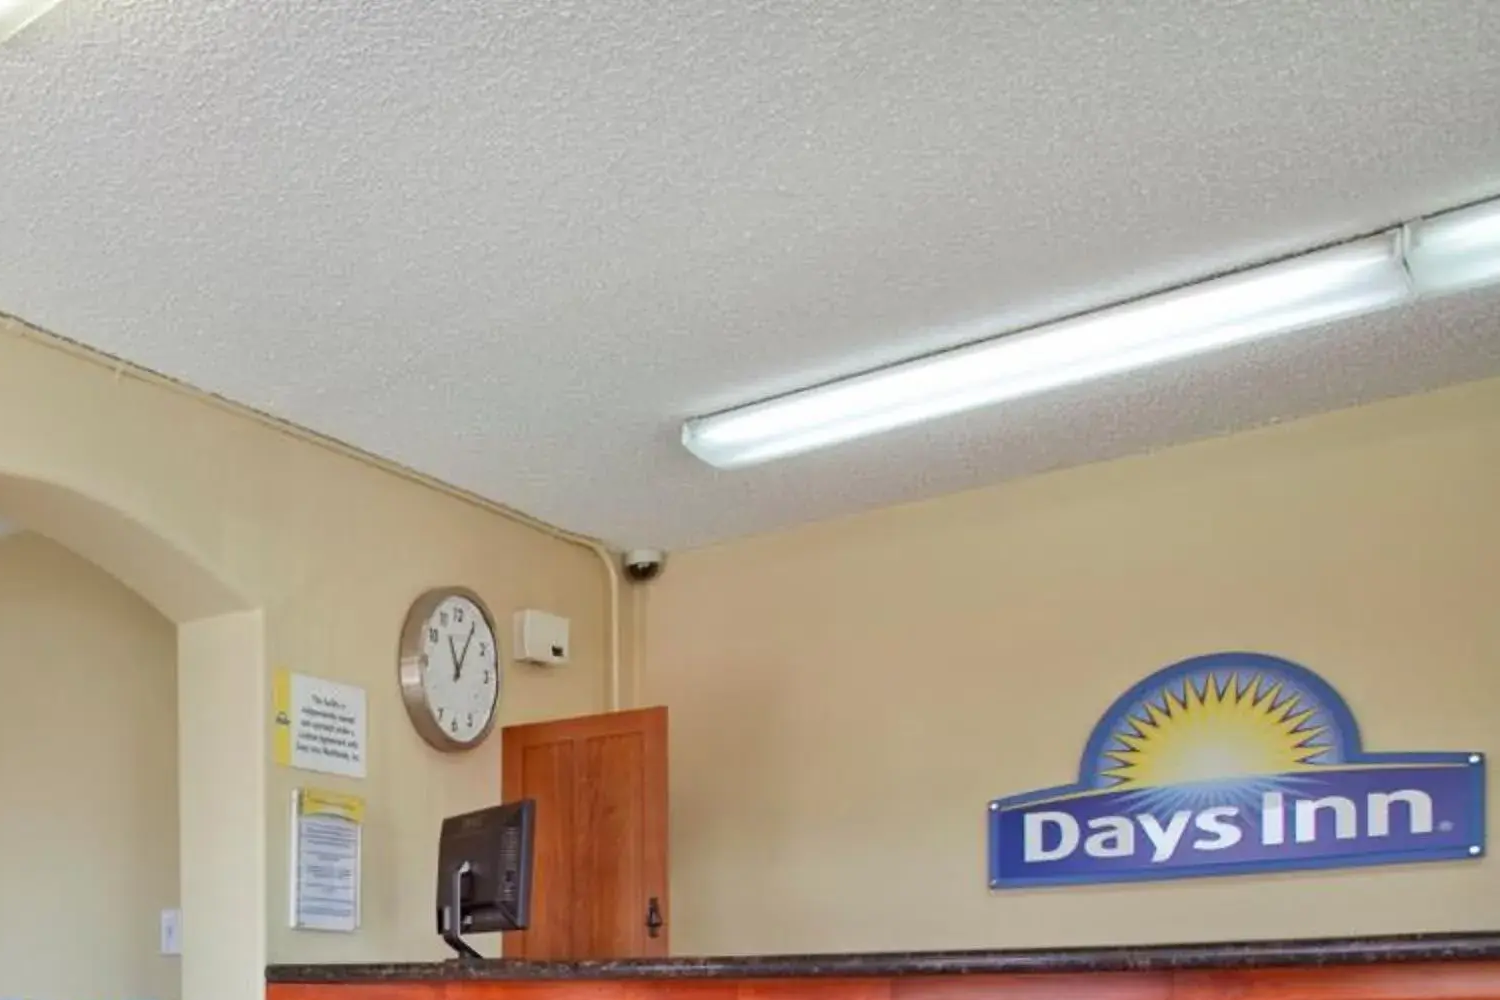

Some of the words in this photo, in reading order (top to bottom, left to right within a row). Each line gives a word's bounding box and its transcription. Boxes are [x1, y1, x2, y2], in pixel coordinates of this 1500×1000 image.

[453, 607, 464, 623] 12
[1023, 806, 1243, 863] Days
[1262, 789, 1433, 846] Inn
